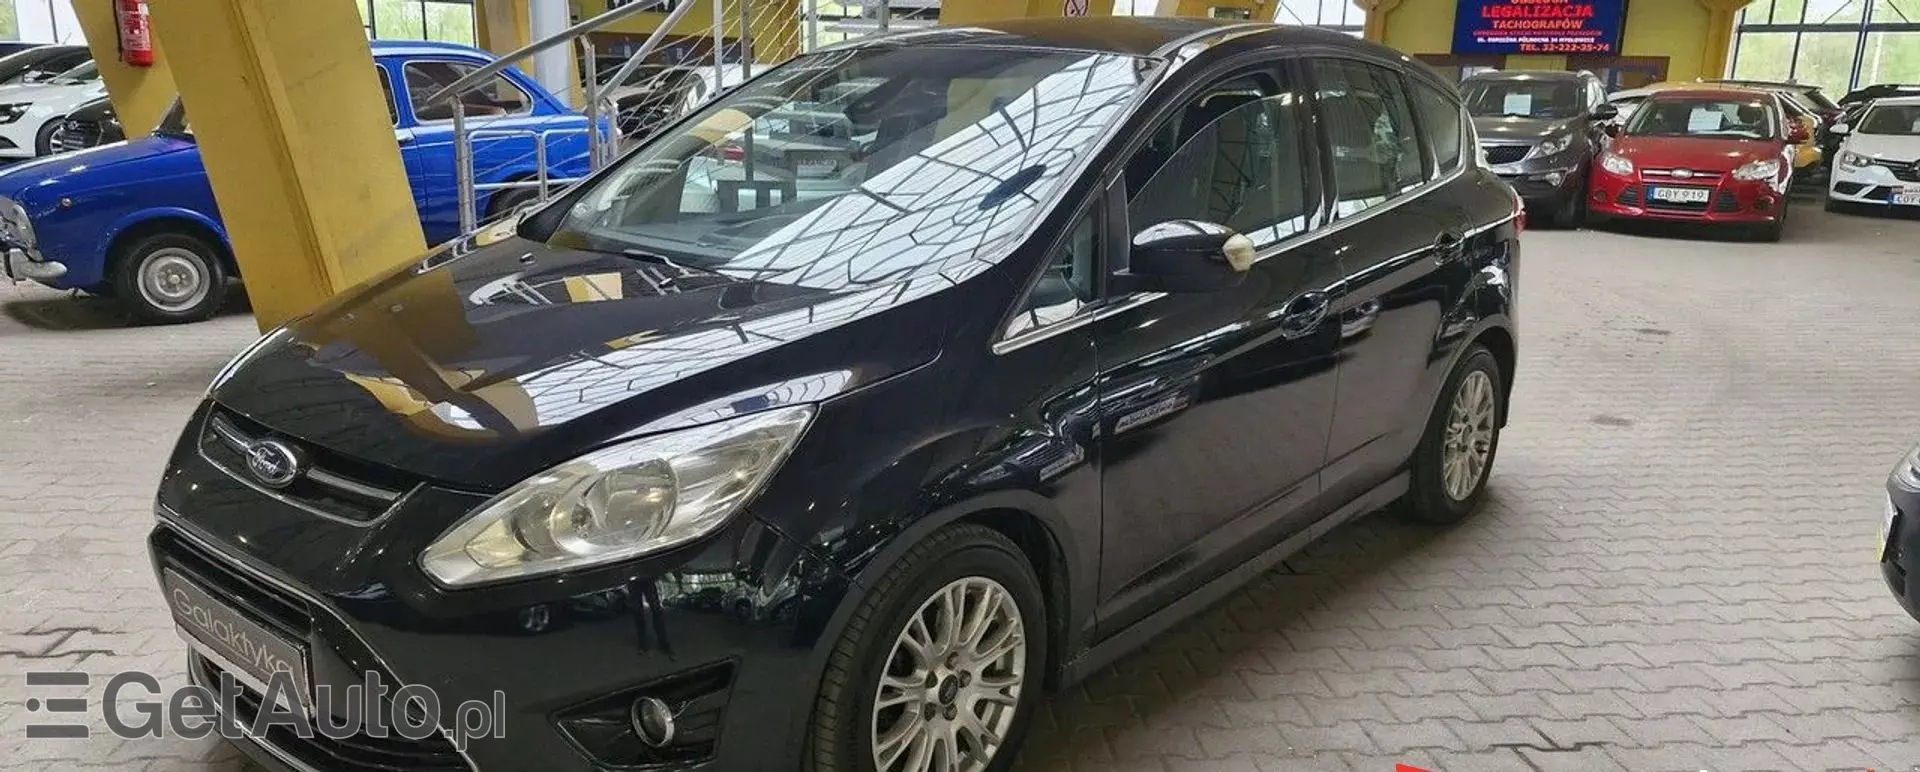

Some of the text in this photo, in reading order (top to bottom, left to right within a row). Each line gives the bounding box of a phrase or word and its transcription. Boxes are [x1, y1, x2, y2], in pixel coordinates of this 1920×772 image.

[1481, 5, 1594, 18] LEGALIZACJA
[1493, 18, 1583, 29] TACHOGRAFÓW
[1520, 43, 1540, 52] TEL.
[252, 447, 280, 475] Ford
